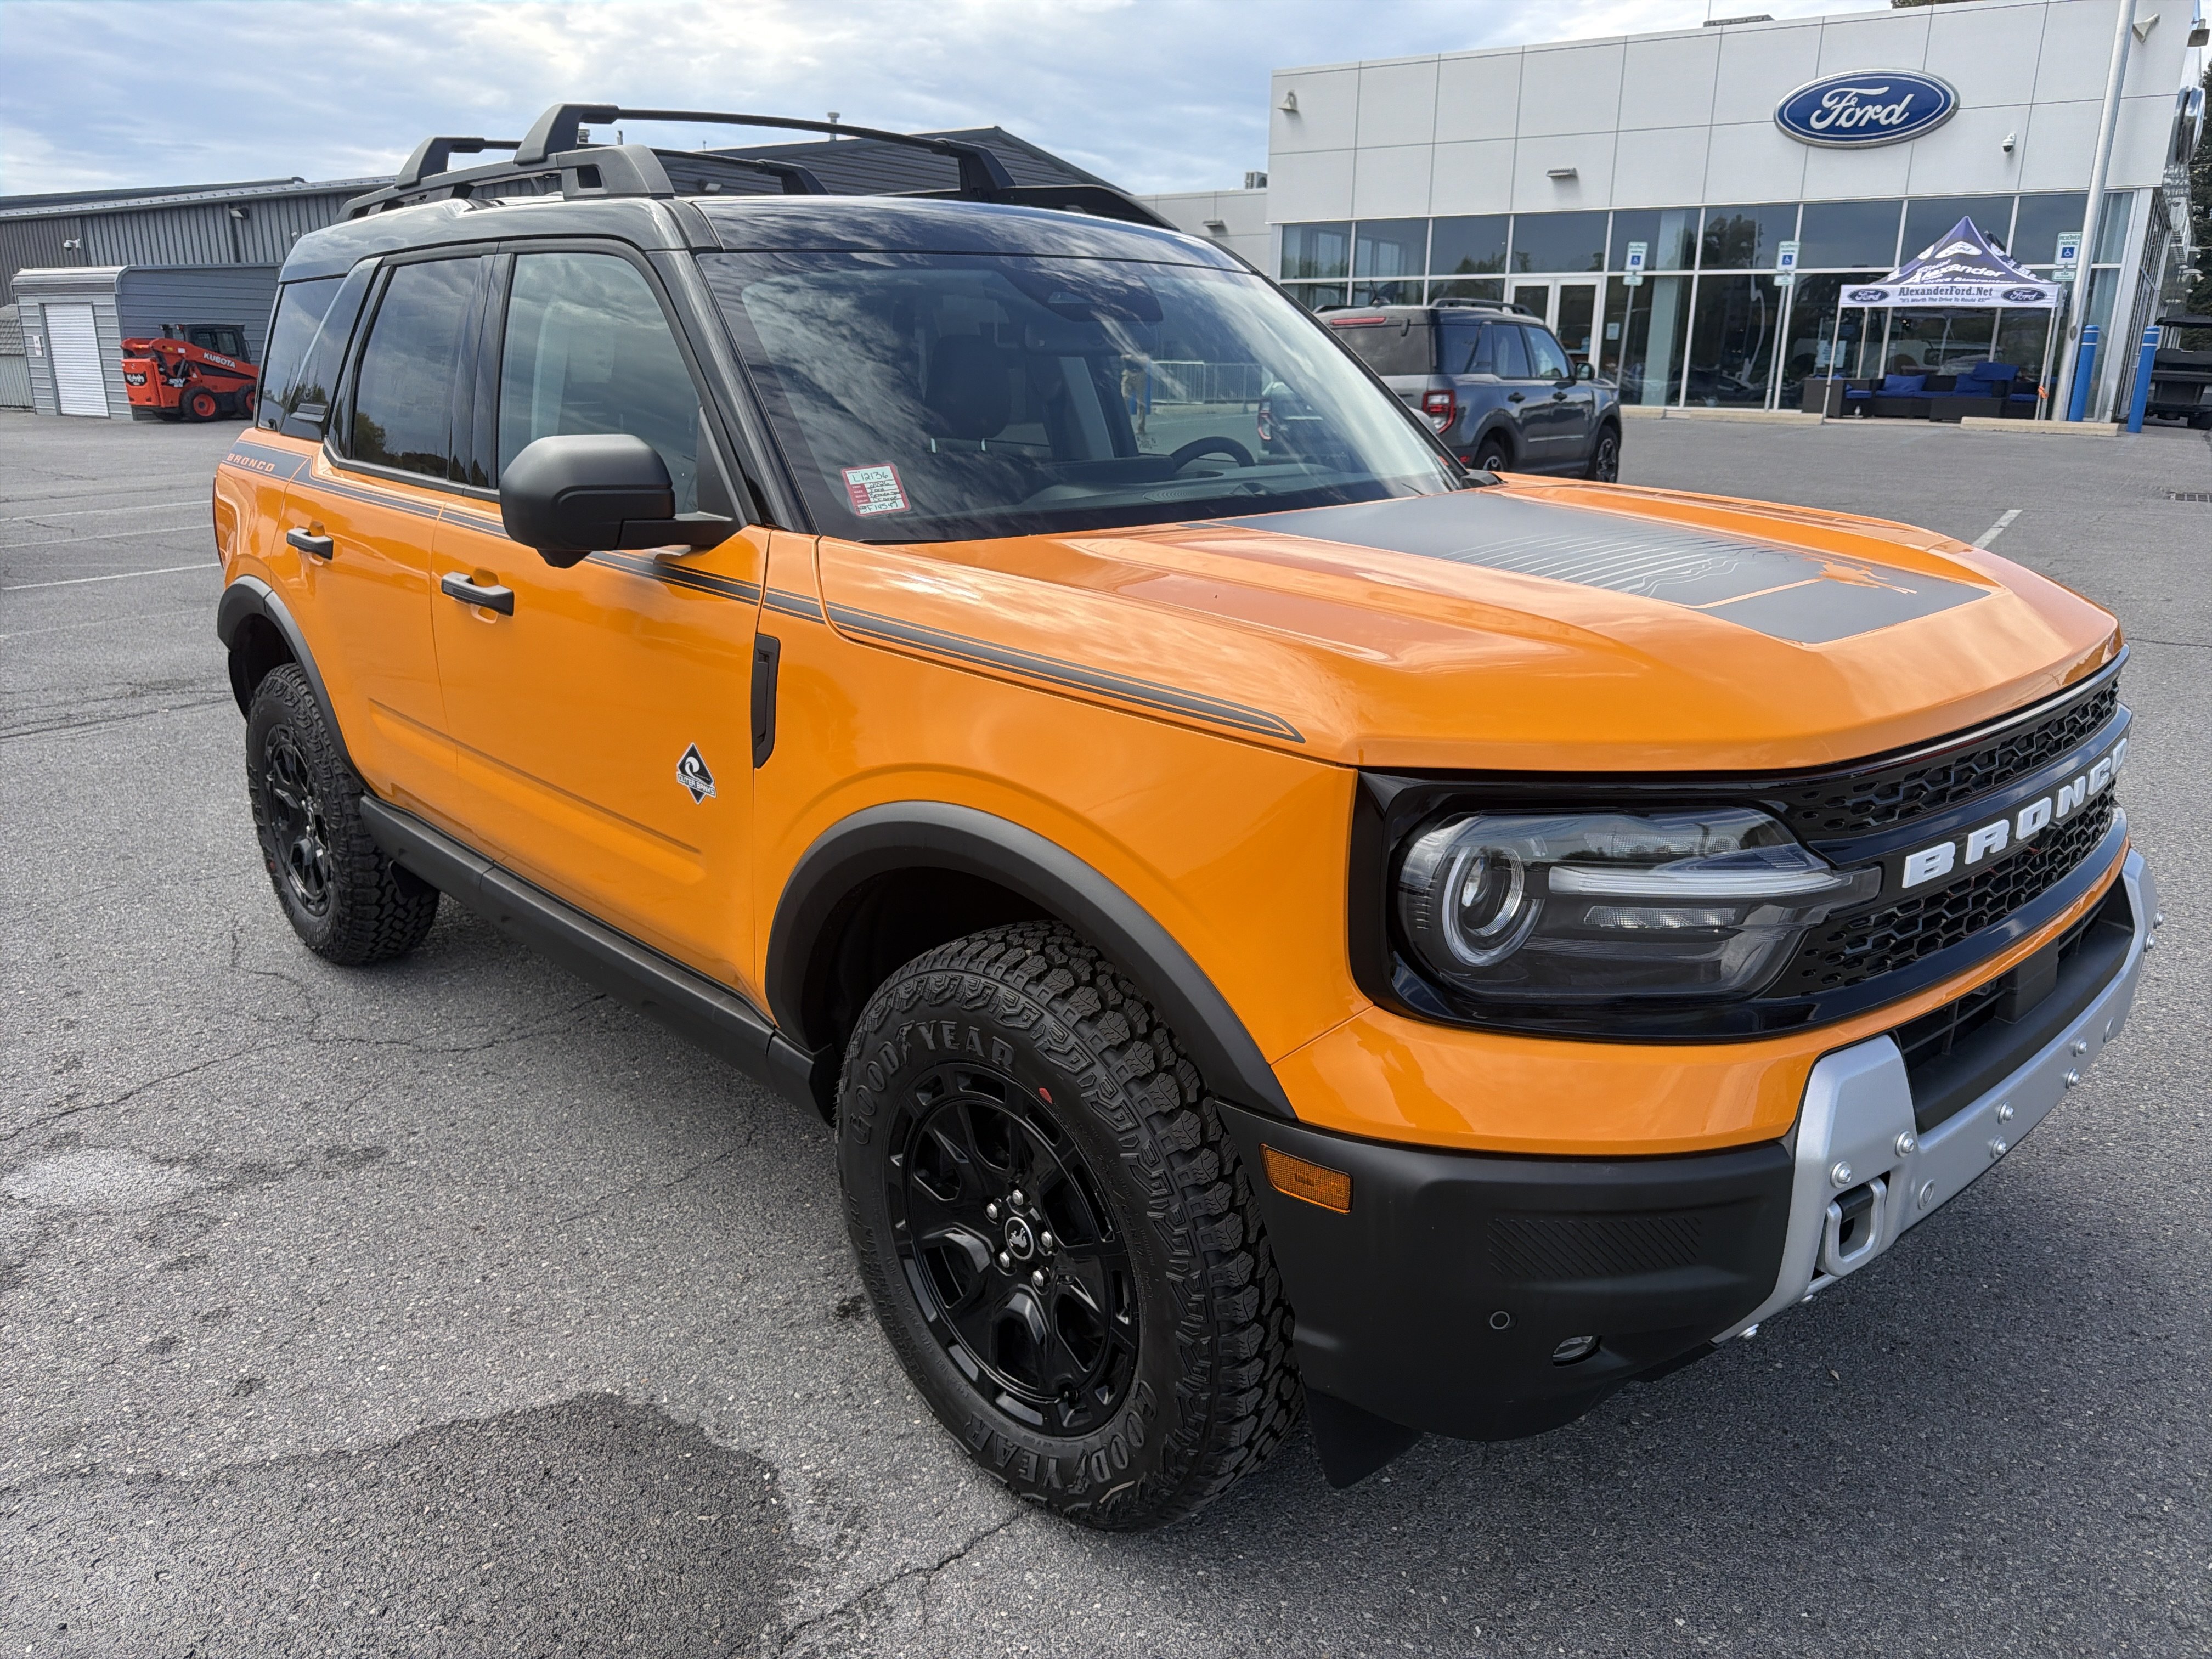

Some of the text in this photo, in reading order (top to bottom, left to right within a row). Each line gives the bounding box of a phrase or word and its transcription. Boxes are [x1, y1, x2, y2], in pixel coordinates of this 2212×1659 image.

[1810, 86, 1915, 129] Ford
[1855, 290, 1882, 300] Ford
[1898, 286, 1993, 296] AlexanderFord.Net
[2010, 290, 2038, 300] Ford
[204, 352, 236, 368] KUBOTA
[227, 453, 275, 472] BRONCO
[851, 472, 889, 482] L12136
[678, 775, 696, 788] OUTER
[696, 782, 715, 795] BANKS
[1902, 738, 2128, 889] BRONCO
